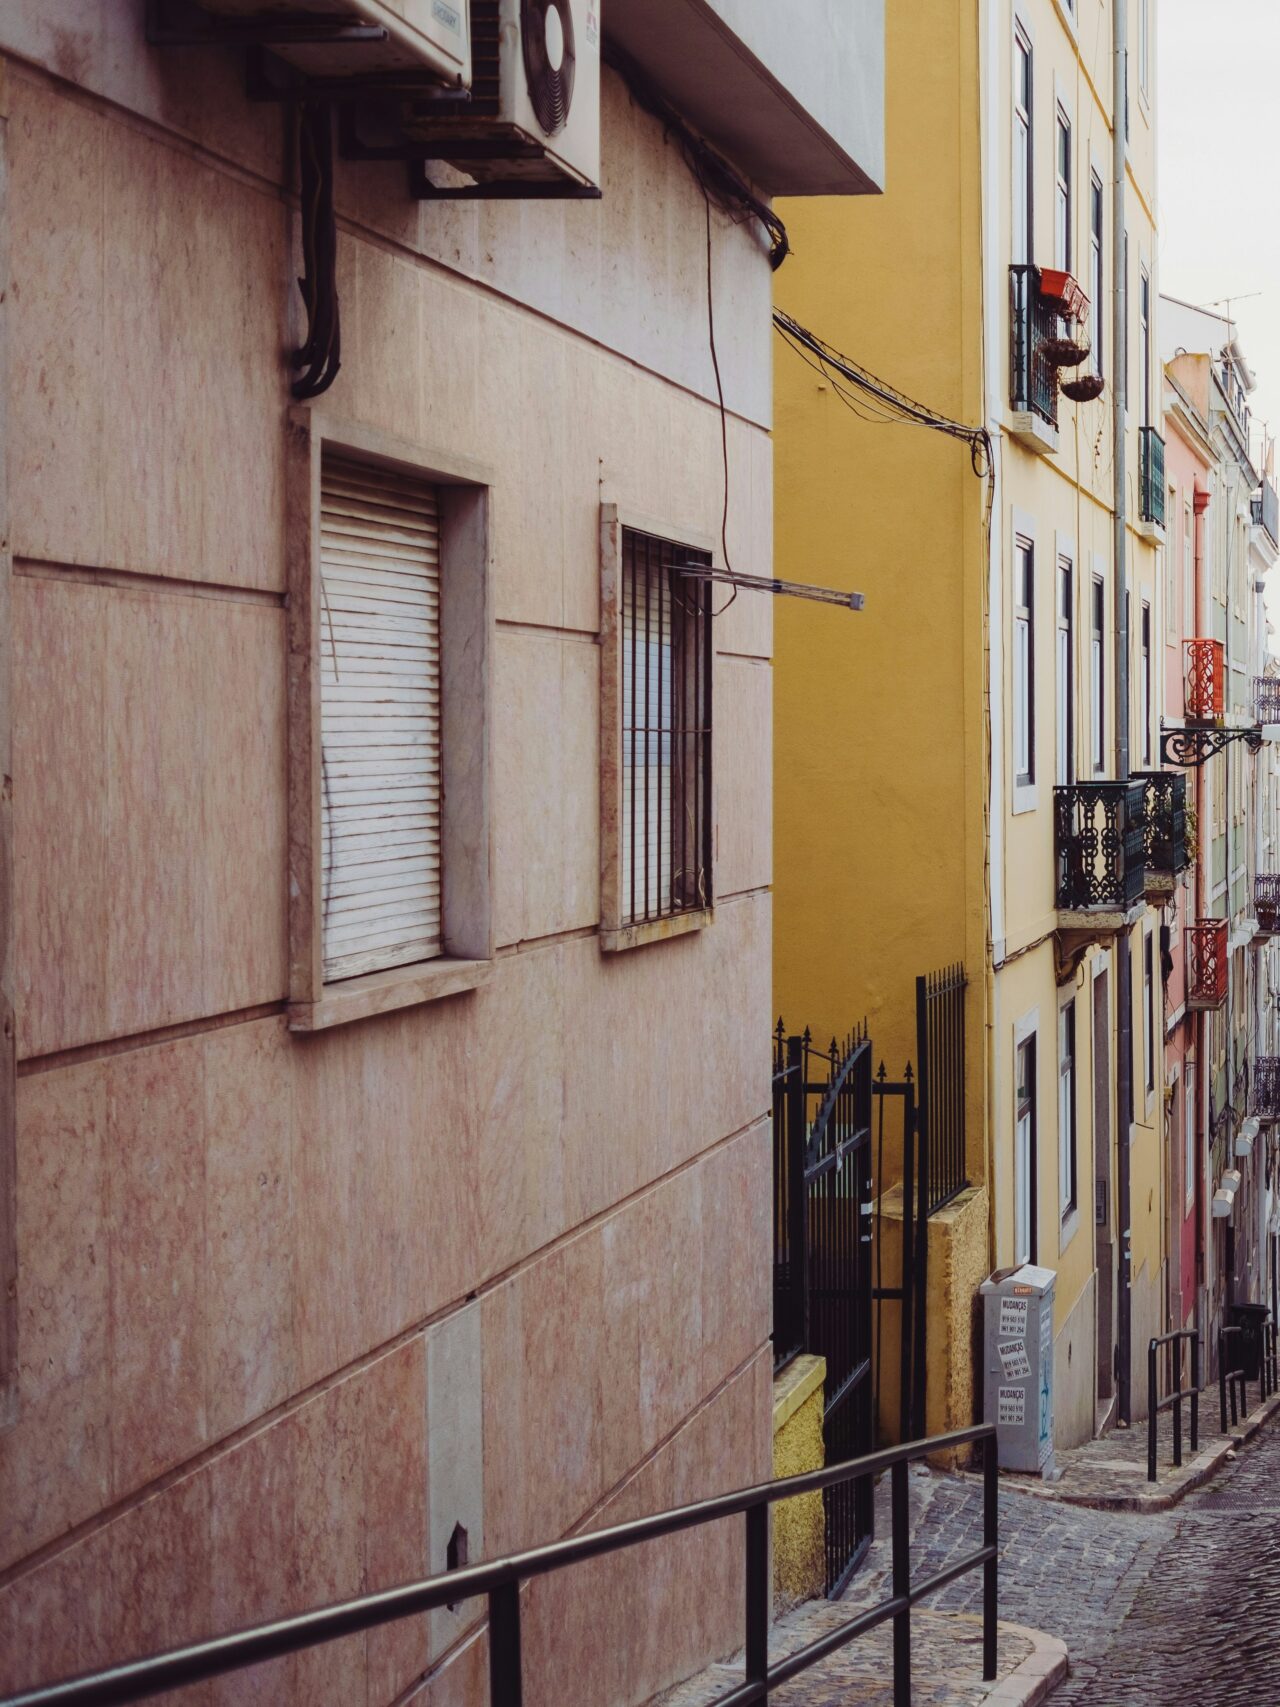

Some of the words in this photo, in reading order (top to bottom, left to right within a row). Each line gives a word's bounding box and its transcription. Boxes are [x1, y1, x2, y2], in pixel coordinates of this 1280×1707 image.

[1003, 1300, 1027, 1312] MUDANÇAS
[1000, 1342, 1023, 1355] MUDANÇAS
[1000, 1389, 1024, 1401] MUDANÇAS
